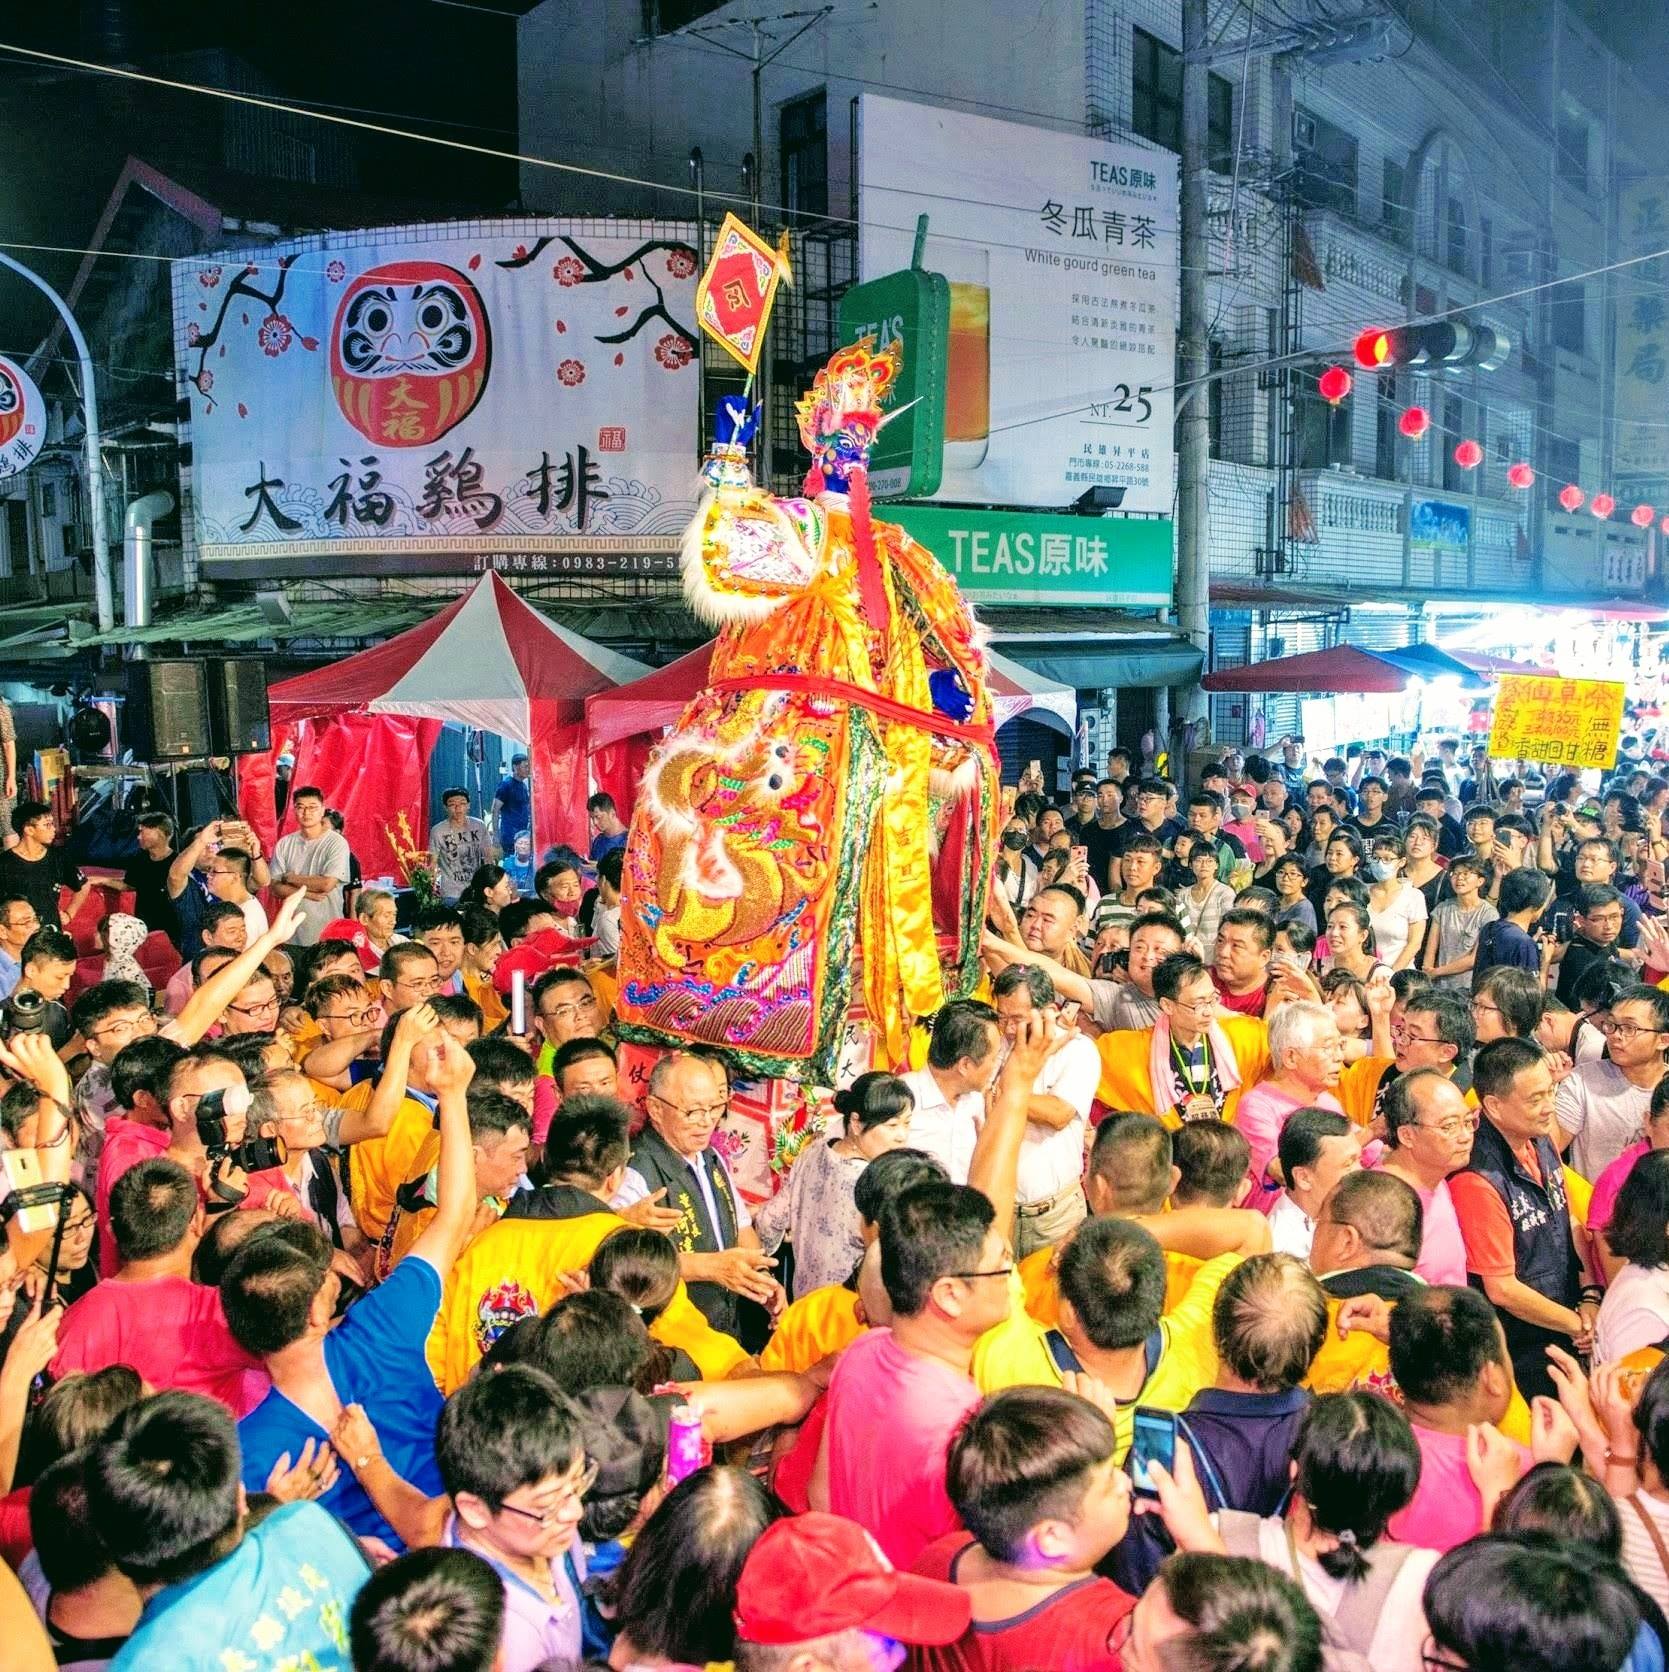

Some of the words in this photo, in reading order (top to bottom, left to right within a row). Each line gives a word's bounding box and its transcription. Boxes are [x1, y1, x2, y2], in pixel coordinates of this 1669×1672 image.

[1040, 199, 1156, 249] 冬瓜青茶
[1025, 249, 1061, 266] White
[1063, 258, 1098, 272] gourd
[1101, 263, 1135, 276] green
[1138, 268, 1156, 281] tea
[381, 376, 429, 440] 大福
[1113, 383, 1152, 423] 25
[473, 554, 682, 571] 訂購專線:0983-219-5
